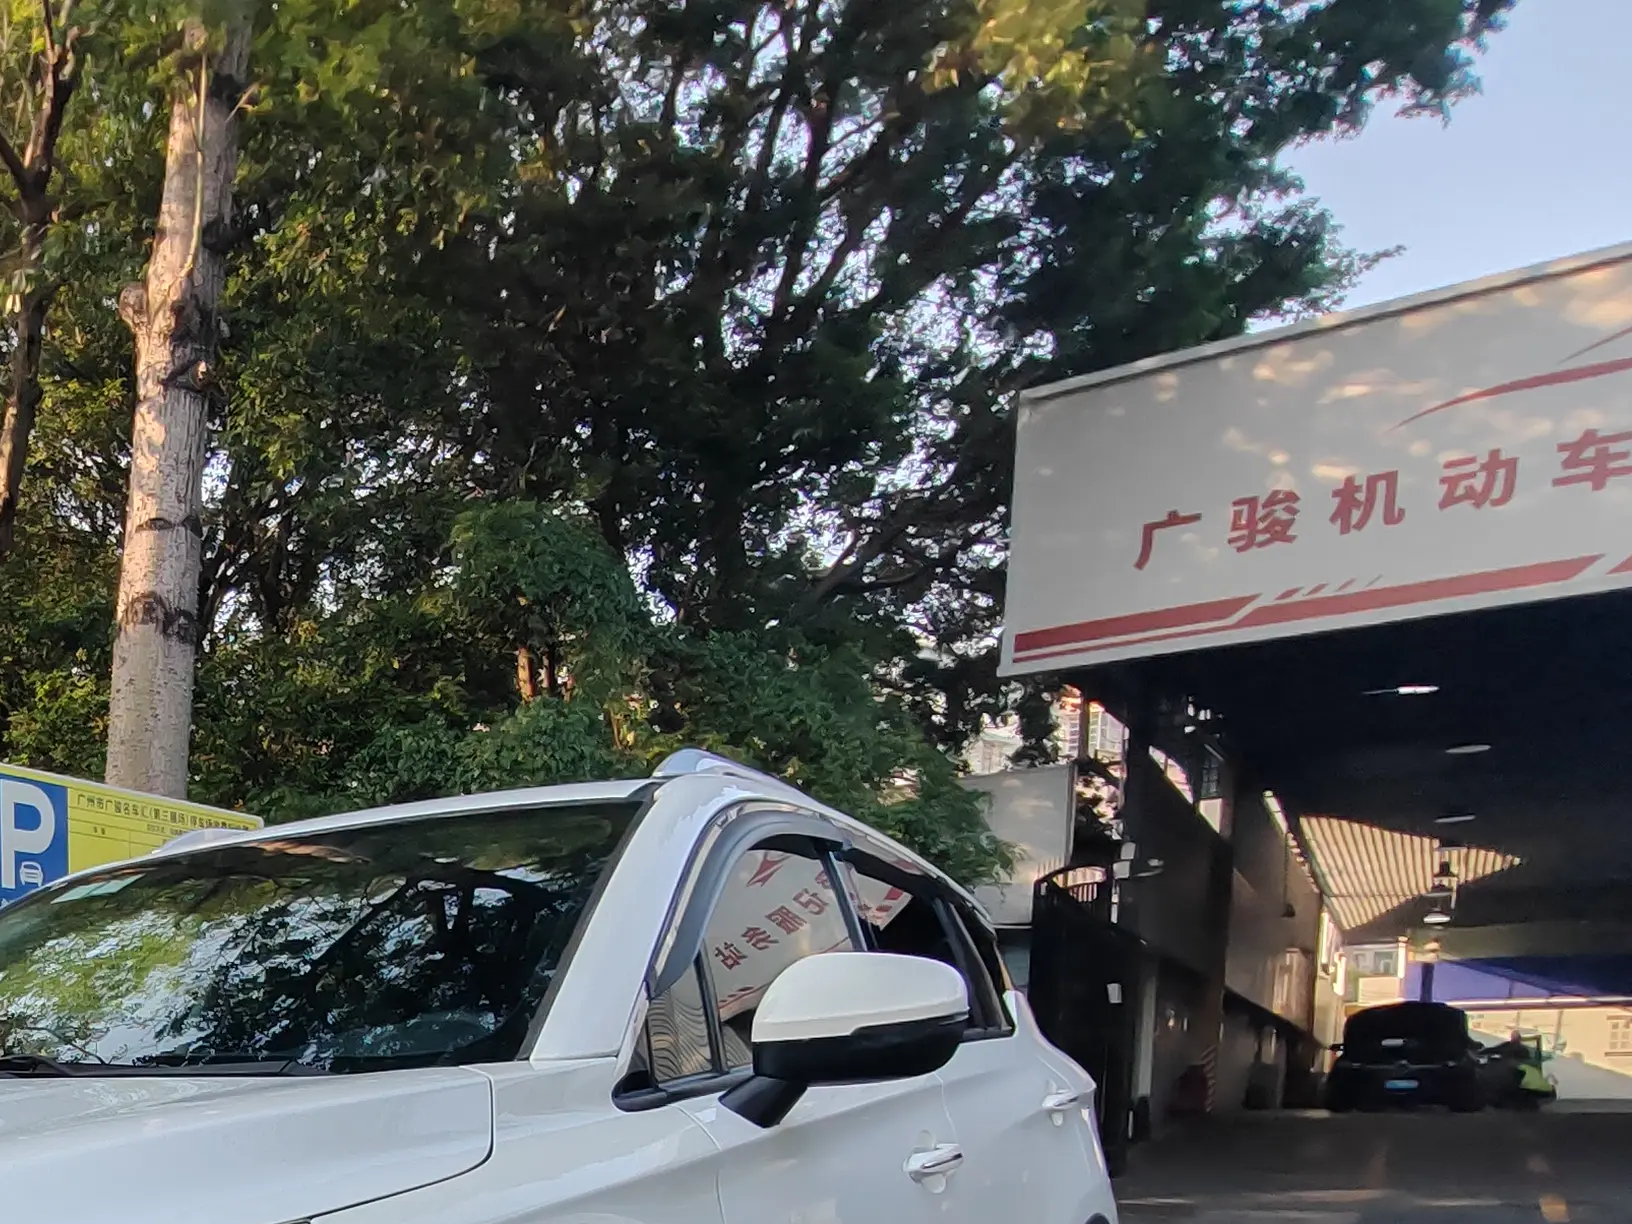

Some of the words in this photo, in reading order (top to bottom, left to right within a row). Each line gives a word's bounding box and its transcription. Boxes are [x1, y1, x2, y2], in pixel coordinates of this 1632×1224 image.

[1134, 429, 1632, 570] 广骏机动车
[0, 779, 56, 889] P
